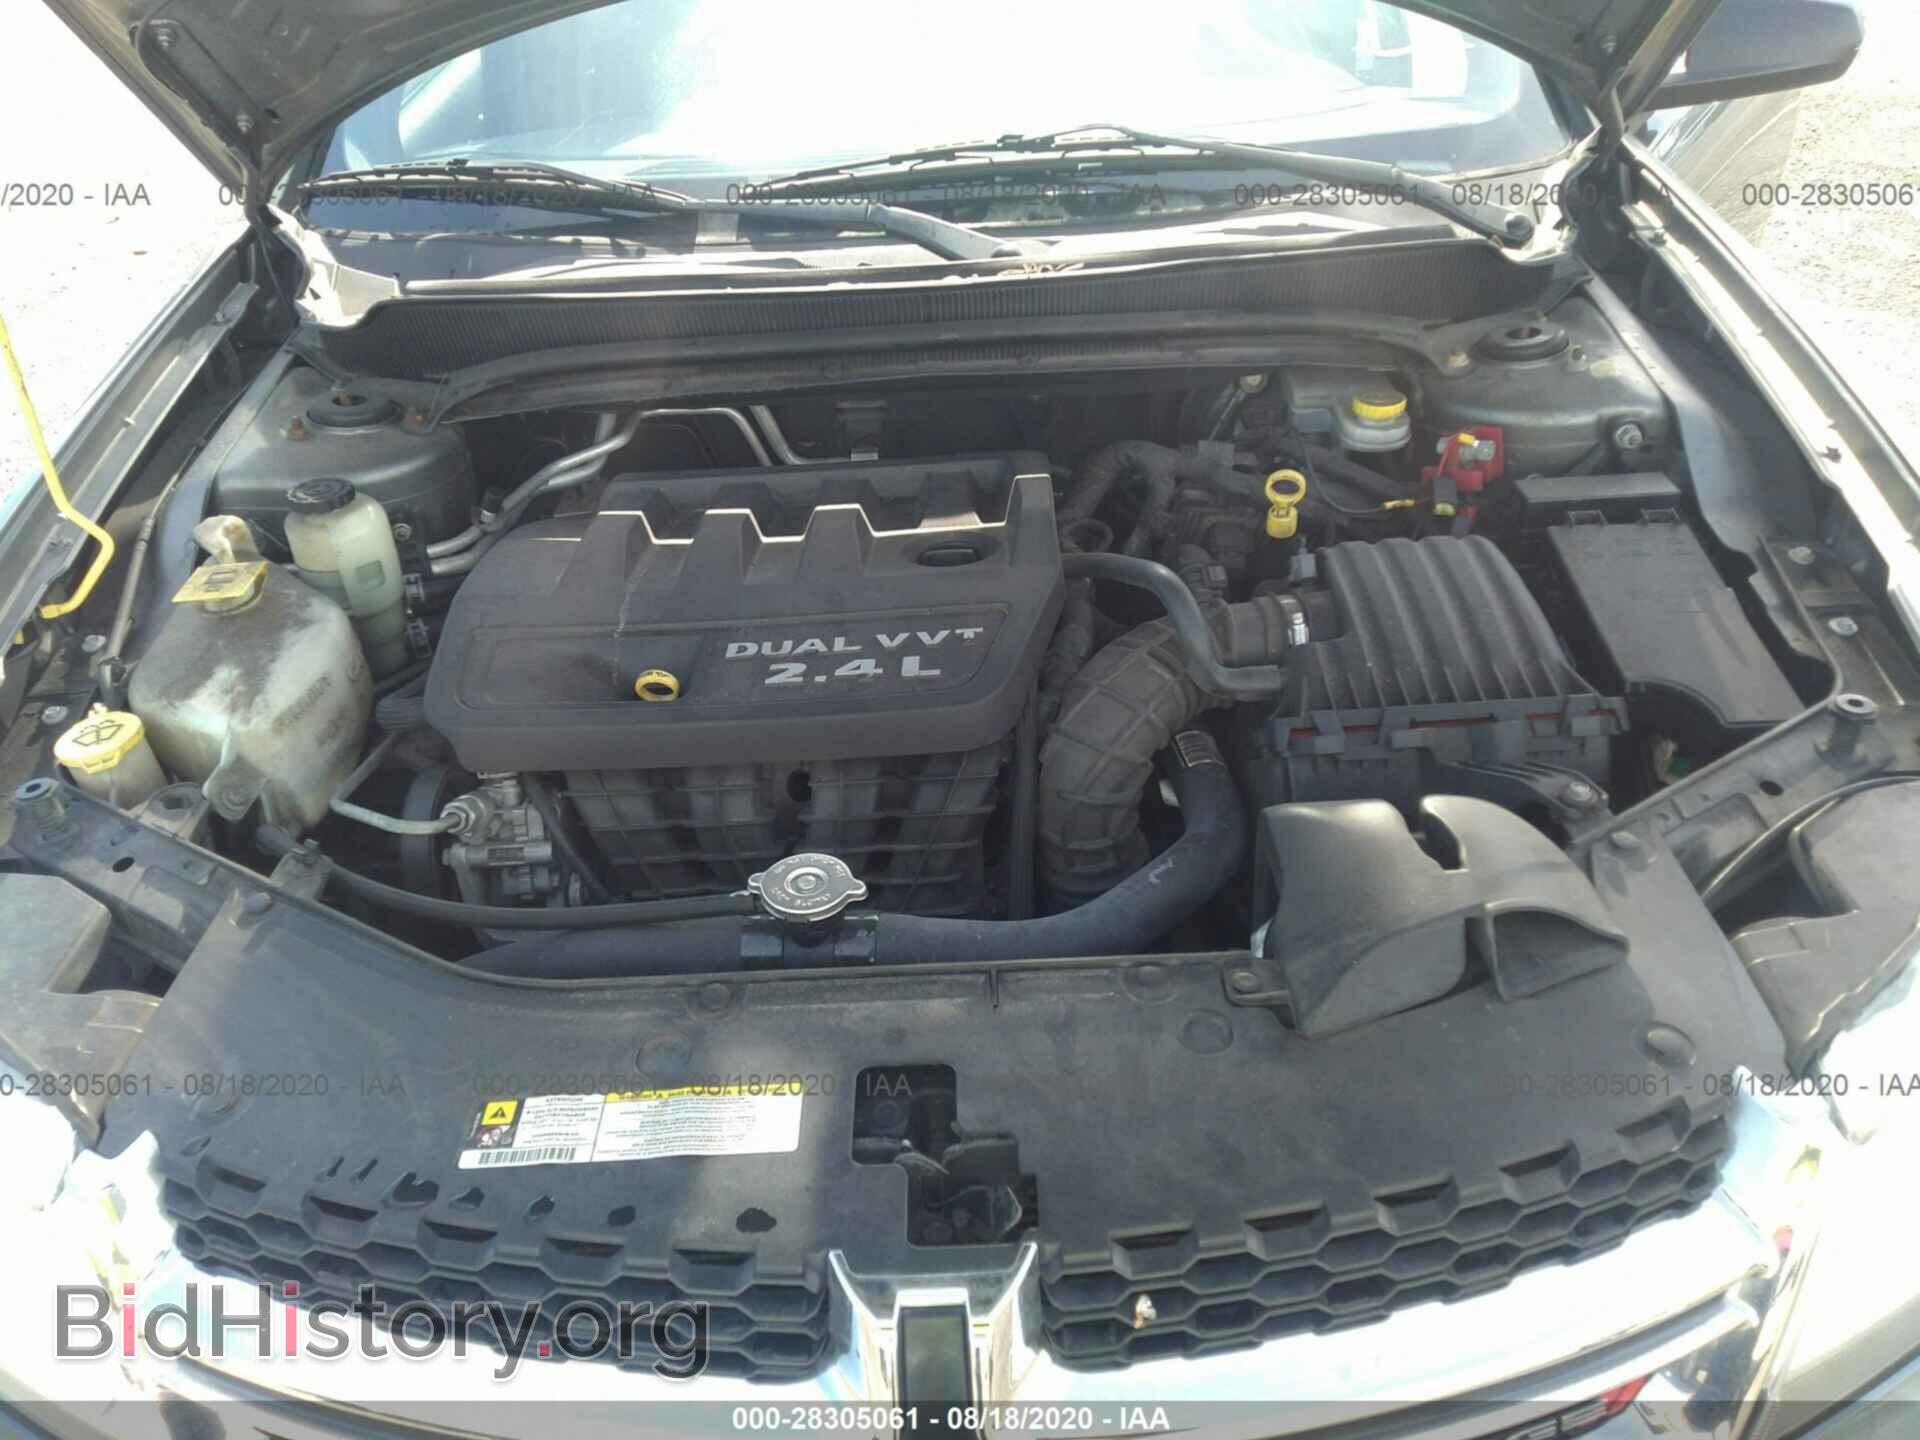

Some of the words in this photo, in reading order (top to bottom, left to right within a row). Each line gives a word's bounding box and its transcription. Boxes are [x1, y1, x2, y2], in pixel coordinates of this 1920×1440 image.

[725, 636, 863, 659] DUAL
[876, 627, 984, 649] VVT
[764, 658, 884, 685] 2.4
[901, 655, 942, 677] L
